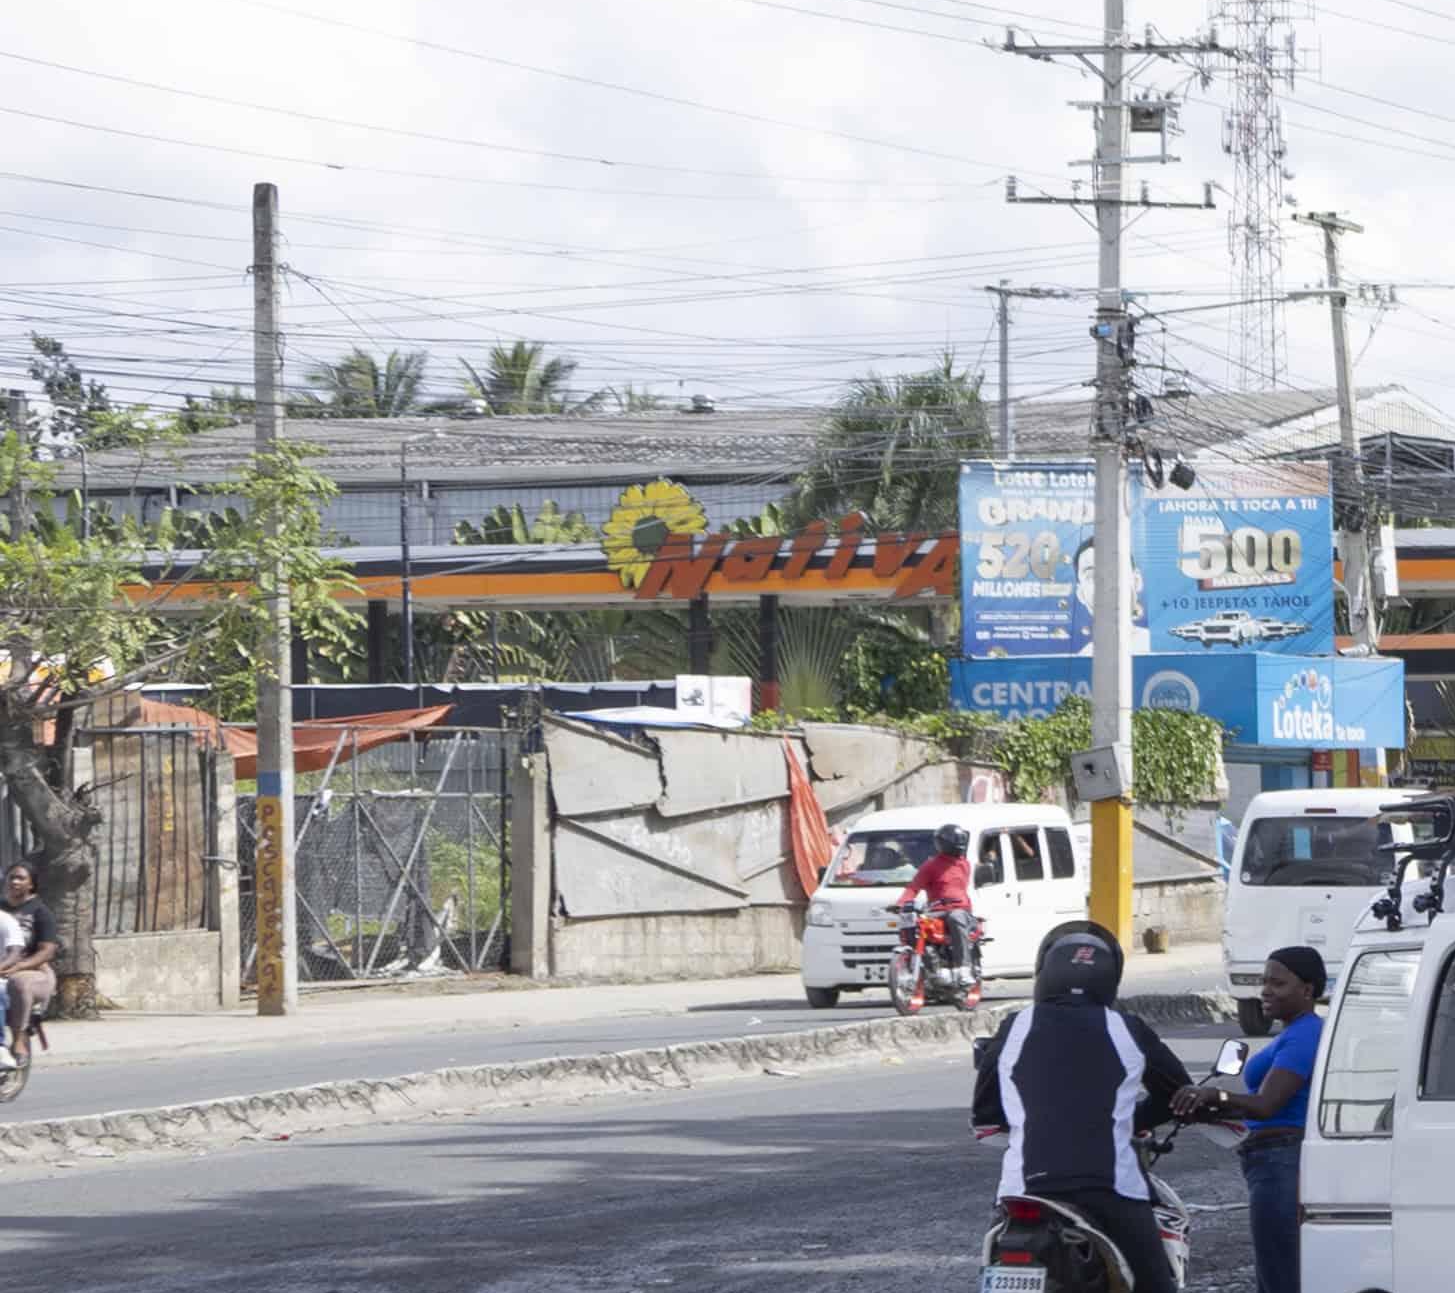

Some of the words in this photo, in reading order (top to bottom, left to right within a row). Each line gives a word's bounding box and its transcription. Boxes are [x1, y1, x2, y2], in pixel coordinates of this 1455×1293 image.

[977, 531, 1059, 579] 520
[1178, 527, 1302, 579] 500
[972, 680, 1096, 706] CENTRA
[1273, 701, 1334, 740] Loteka
